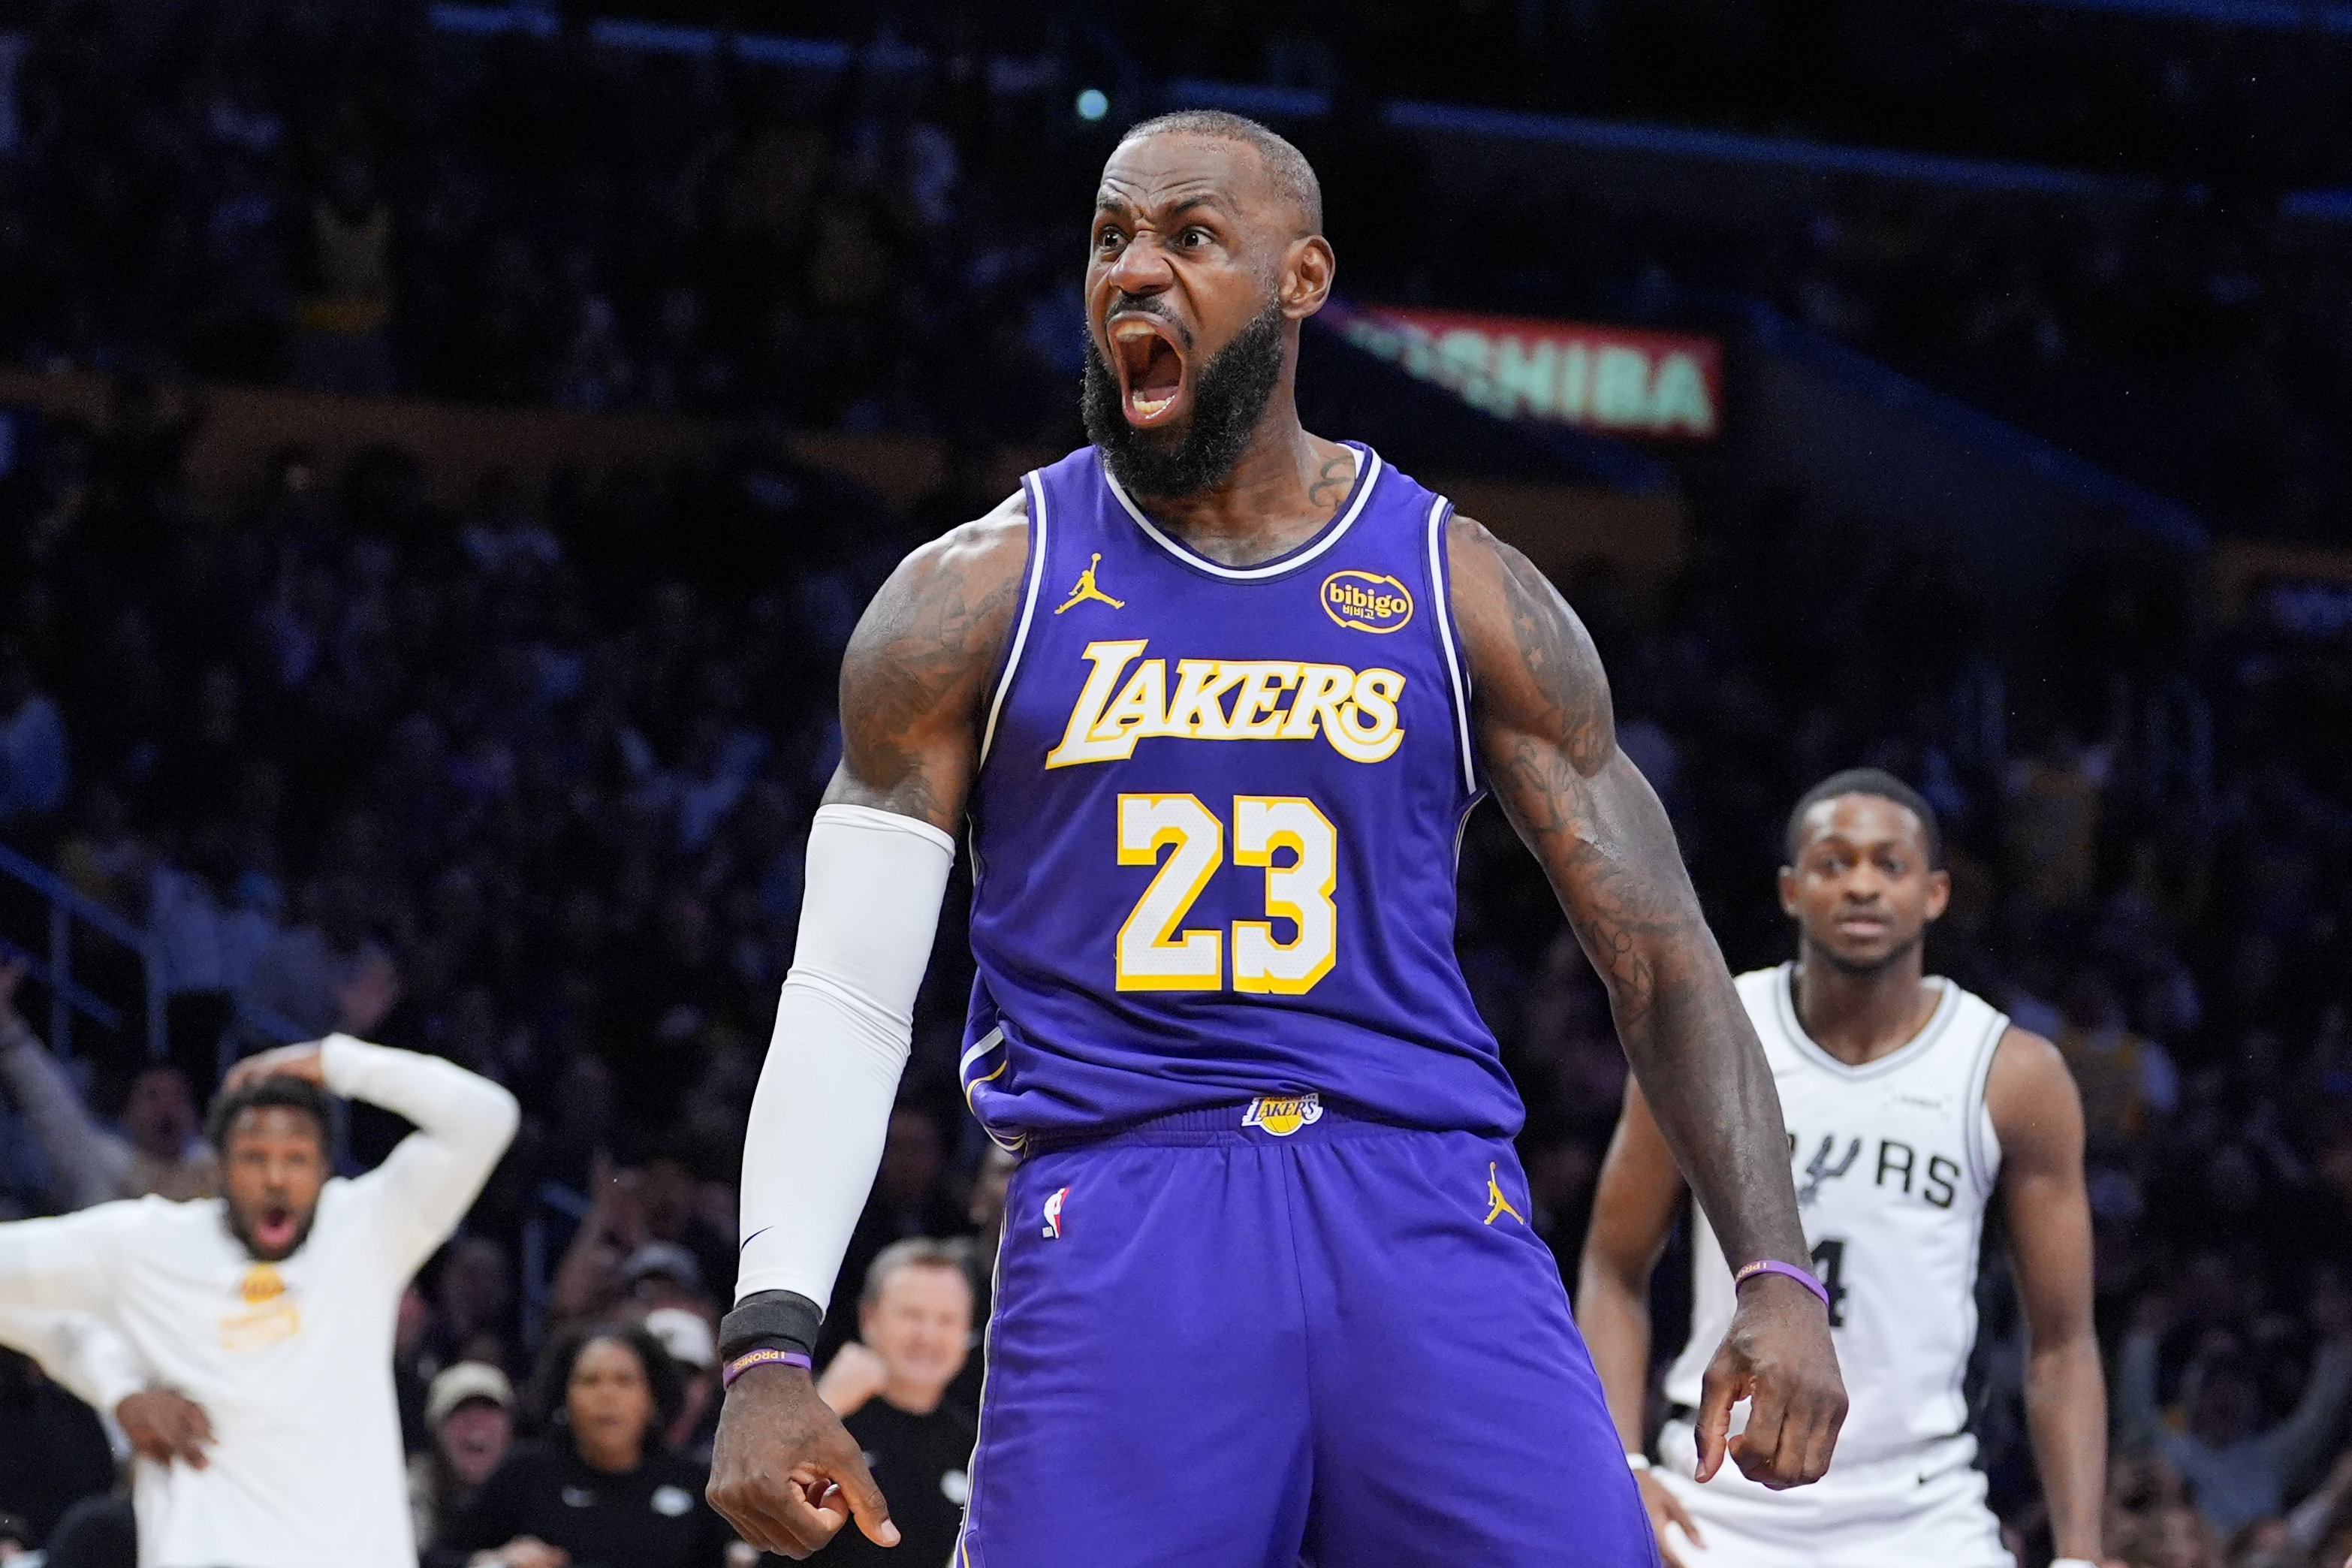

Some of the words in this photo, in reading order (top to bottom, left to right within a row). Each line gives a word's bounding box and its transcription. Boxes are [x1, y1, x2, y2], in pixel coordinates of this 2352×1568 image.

[1349, 318, 1713, 436] SHIBA
[1330, 583, 1407, 618] bibigo
[1342, 605, 1375, 620] 비비고
[1045, 639, 1406, 770] LAKERS
[1116, 793, 1337, 994] 23
[1241, 1096, 1323, 1126] LAKERS
[1811, 1238, 1847, 1328] 4
[732, 1351, 778, 1373] PROMISE
[781, 1351, 786, 1359] I
